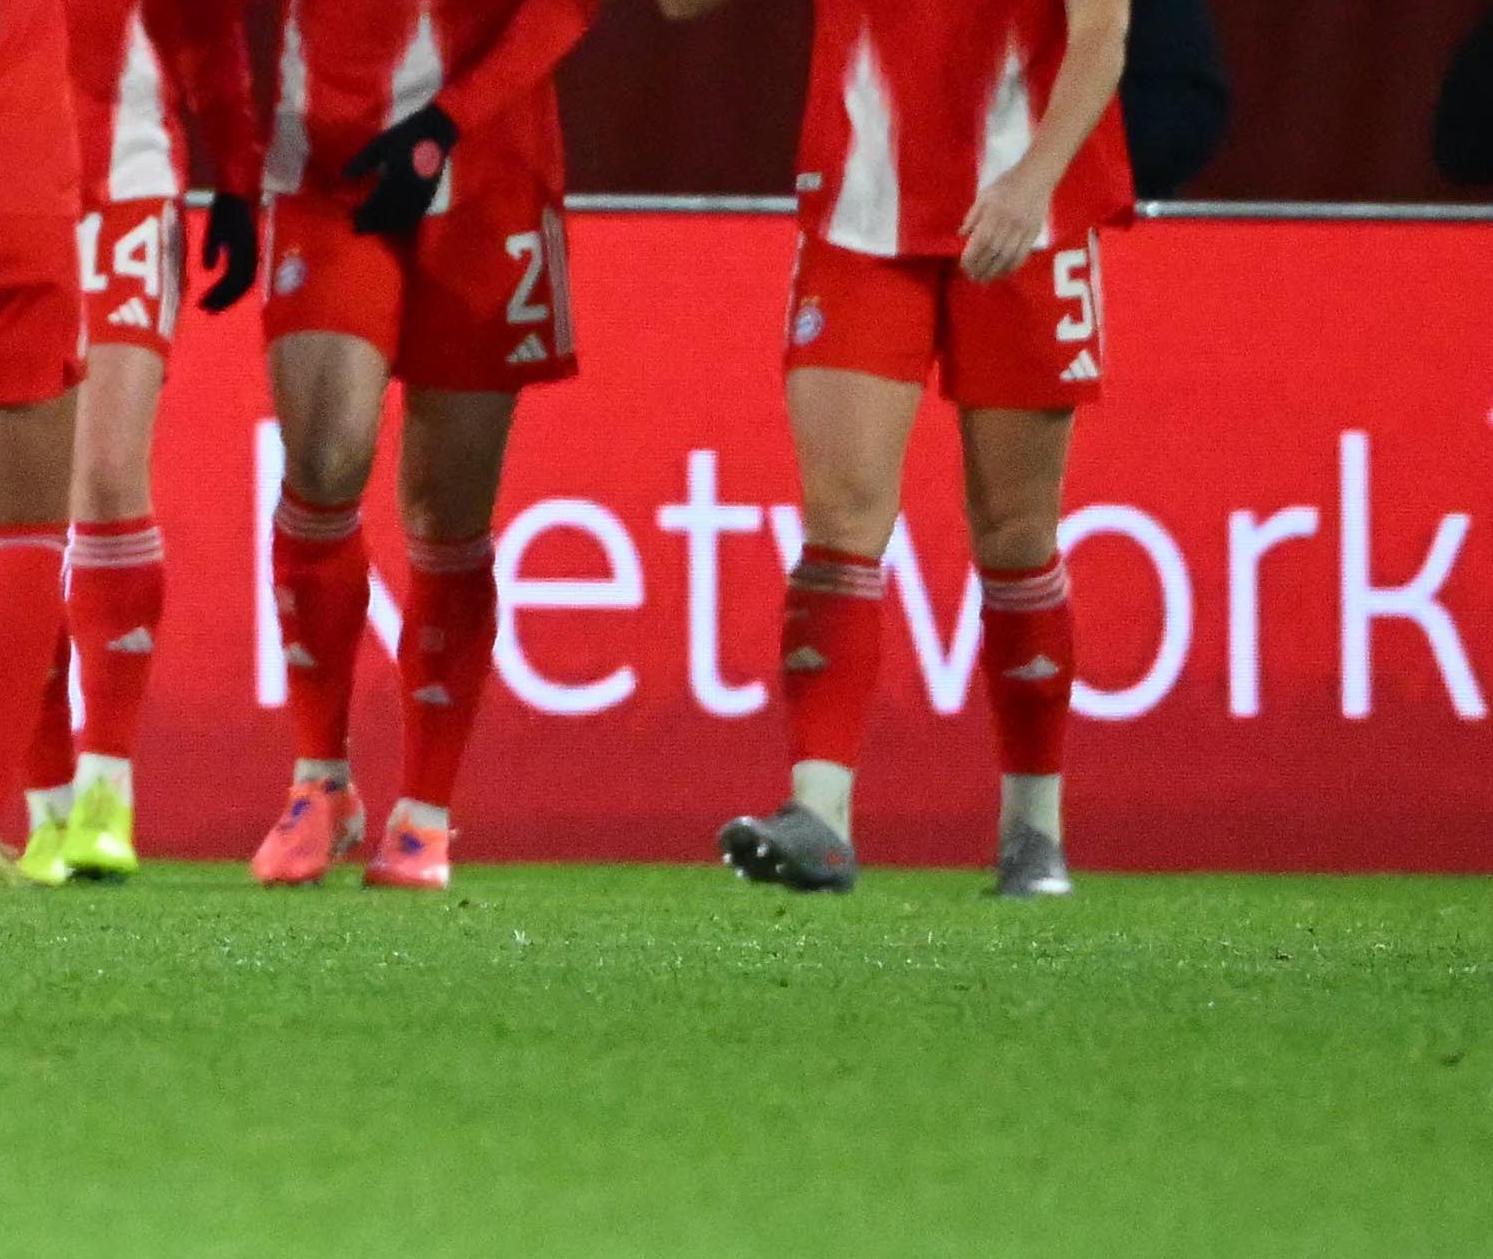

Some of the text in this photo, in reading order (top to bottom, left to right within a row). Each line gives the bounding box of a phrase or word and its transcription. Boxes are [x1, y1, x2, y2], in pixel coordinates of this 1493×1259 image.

[76, 211, 159, 297] 14
[504, 230, 547, 323] 2
[1053, 248, 1095, 342] 5
